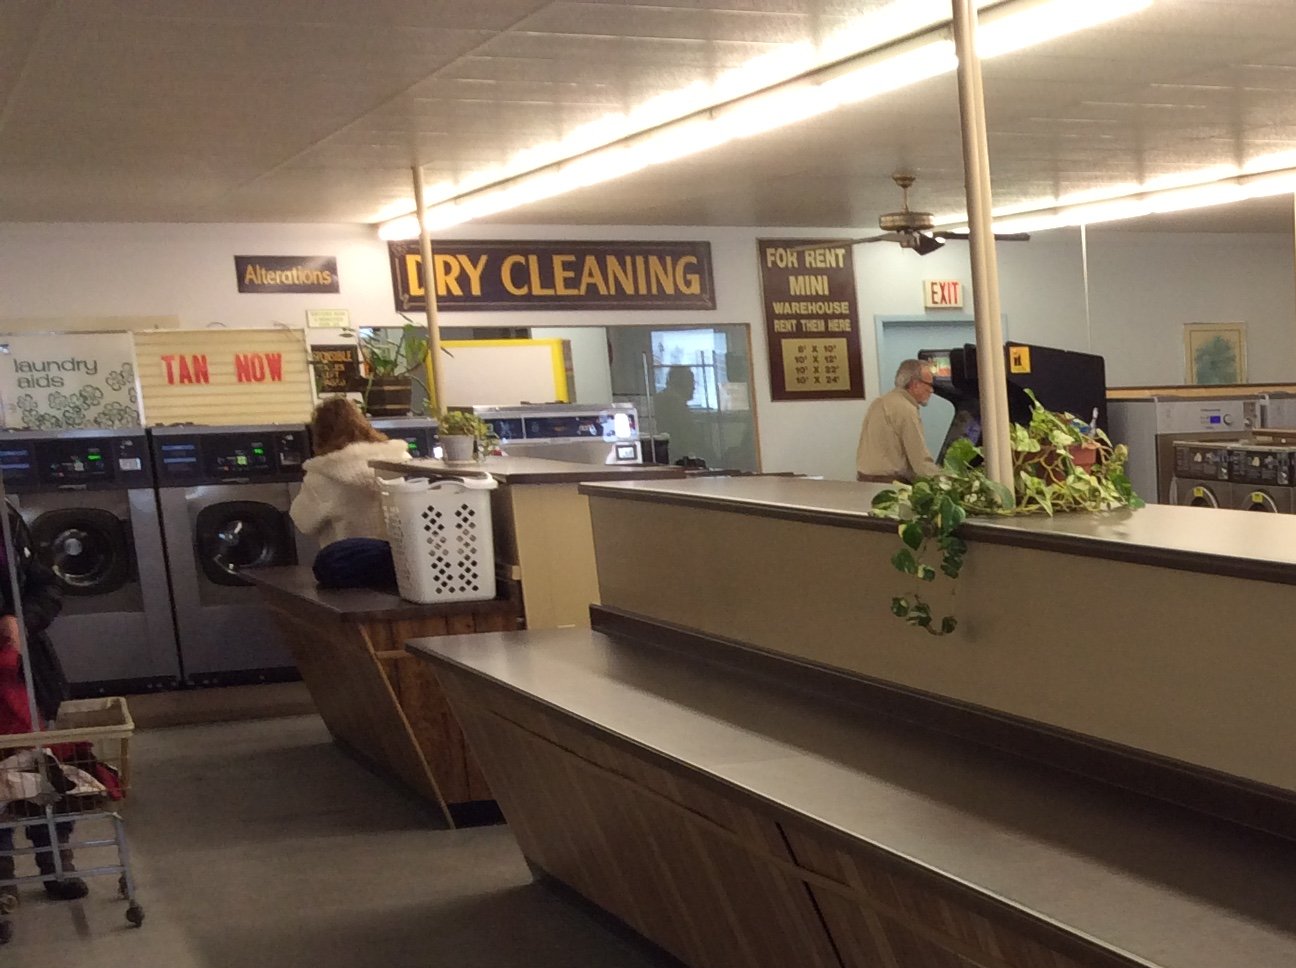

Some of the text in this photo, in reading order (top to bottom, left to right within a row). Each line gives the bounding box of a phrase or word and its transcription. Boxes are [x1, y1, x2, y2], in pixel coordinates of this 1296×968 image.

[766, 247, 845, 268] FOR RENT
[244, 264, 332, 285] Alterations
[405, 254, 701, 296] DRY CLEANING
[788, 275, 829, 296] MINI
[930, 281, 959, 304] EXIT
[772, 302, 849, 314] WAREHOUSE
[773, 319, 851, 333] RENT THEM HERE
[13, 357, 98, 375] laundry
[161, 353, 282, 385] TAN NOW
[17, 374, 65, 388] aids
